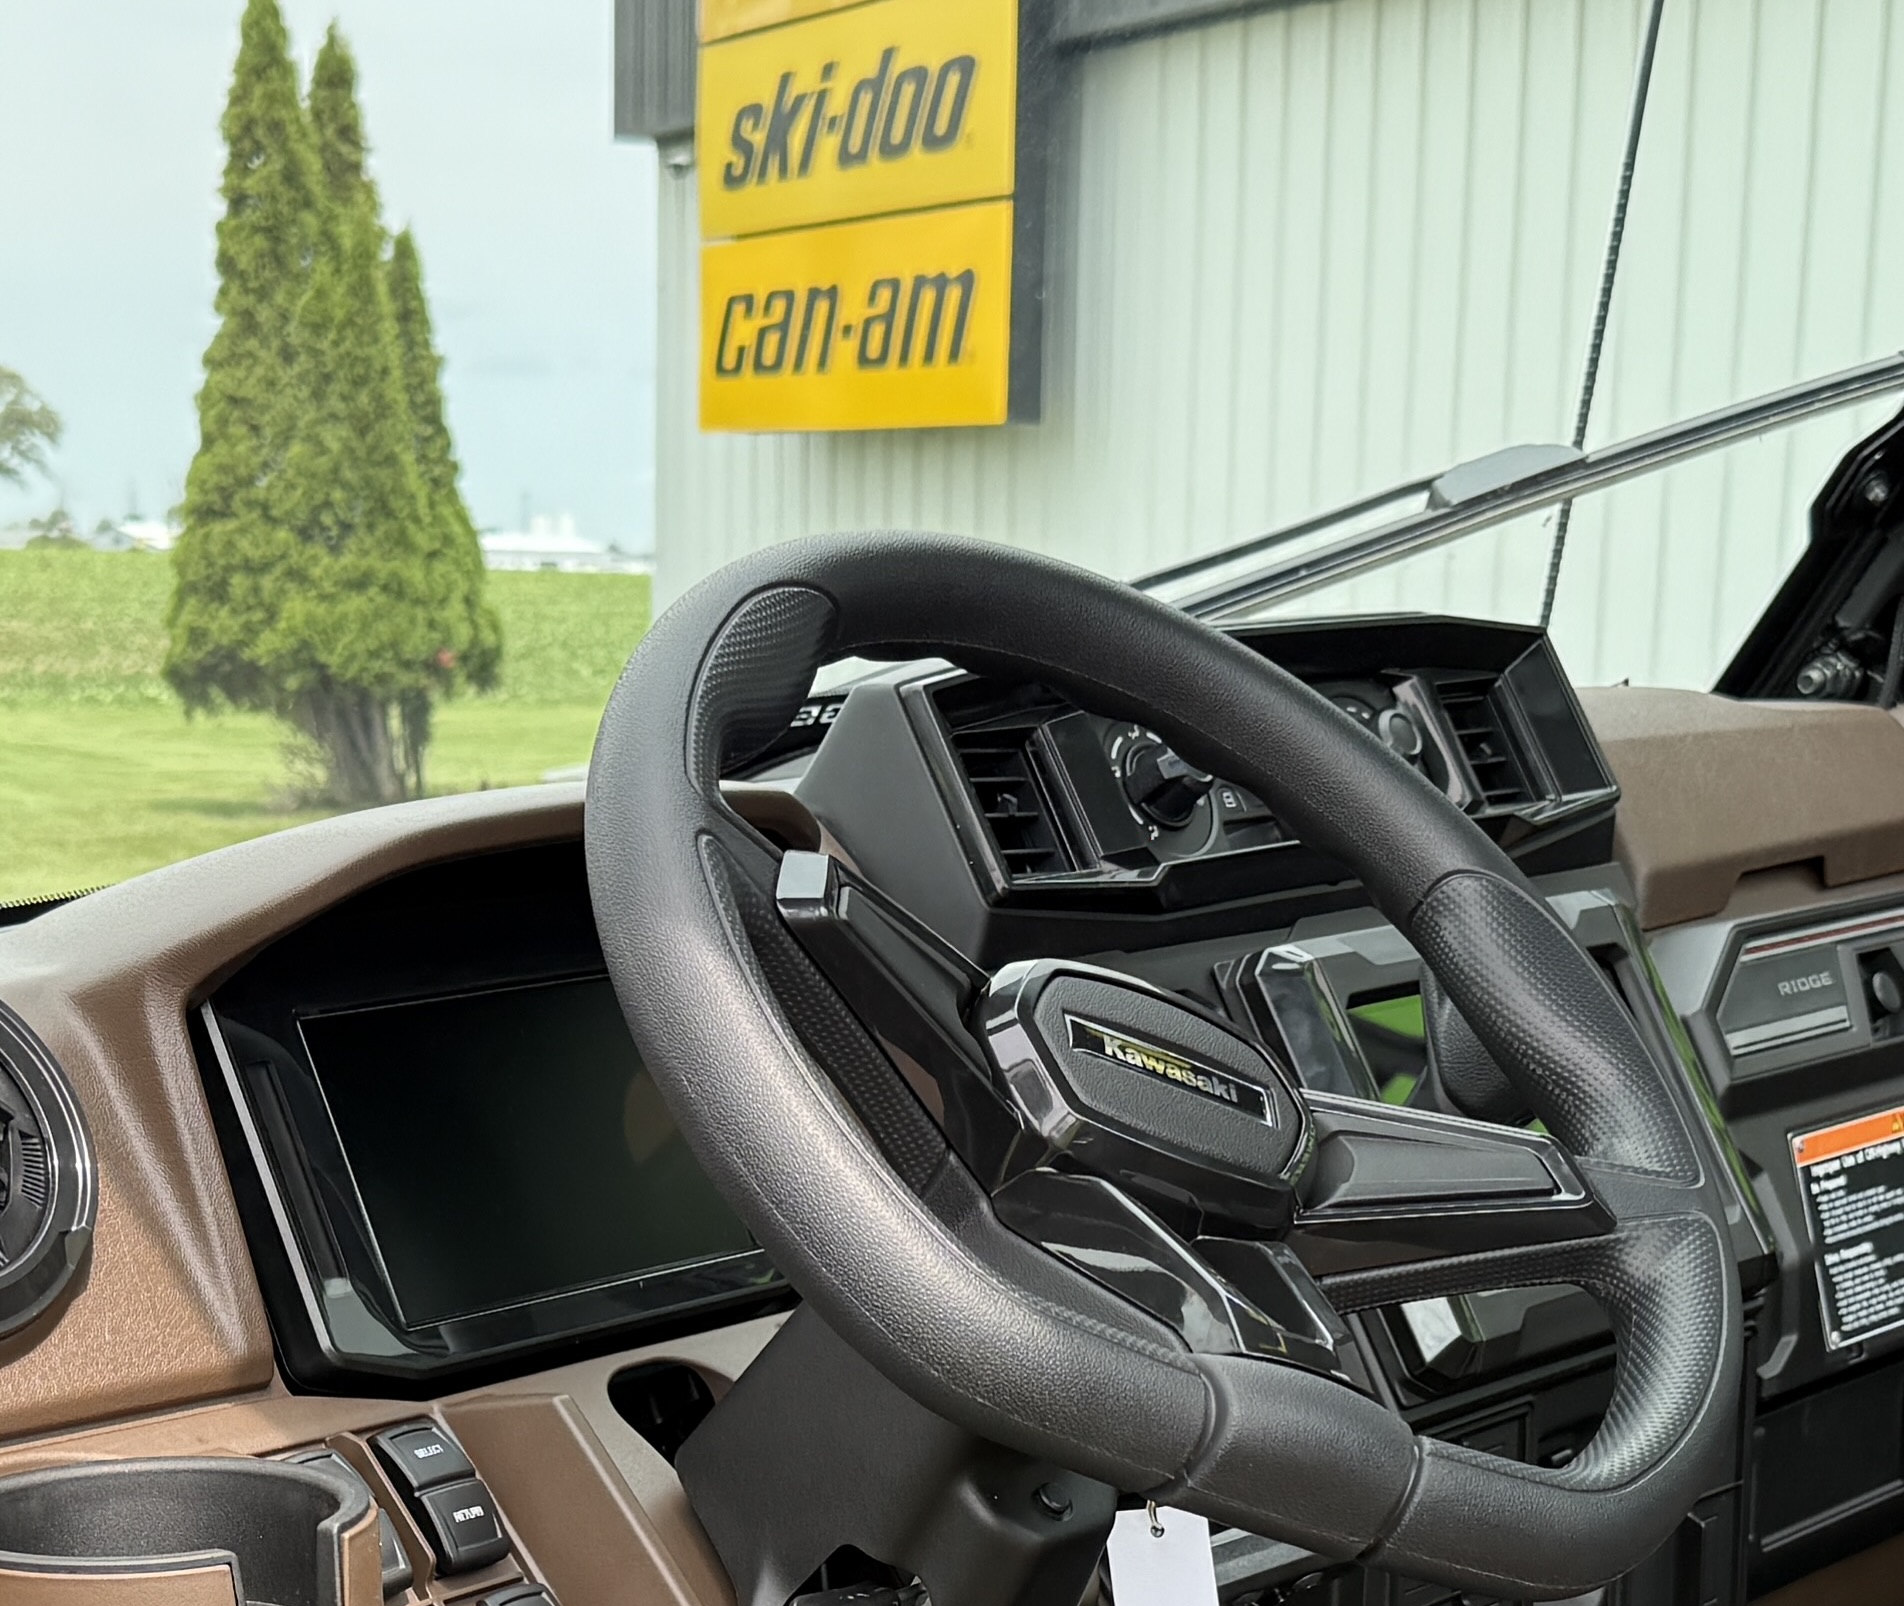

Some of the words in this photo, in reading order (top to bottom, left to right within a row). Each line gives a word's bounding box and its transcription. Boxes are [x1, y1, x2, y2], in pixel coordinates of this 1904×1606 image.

[723, 45, 977, 192] ski-doo
[715, 267, 975, 378] can-am
[1777, 970, 1834, 996] RIDGE
[1102, 1034, 1238, 1103] Kawasaki
